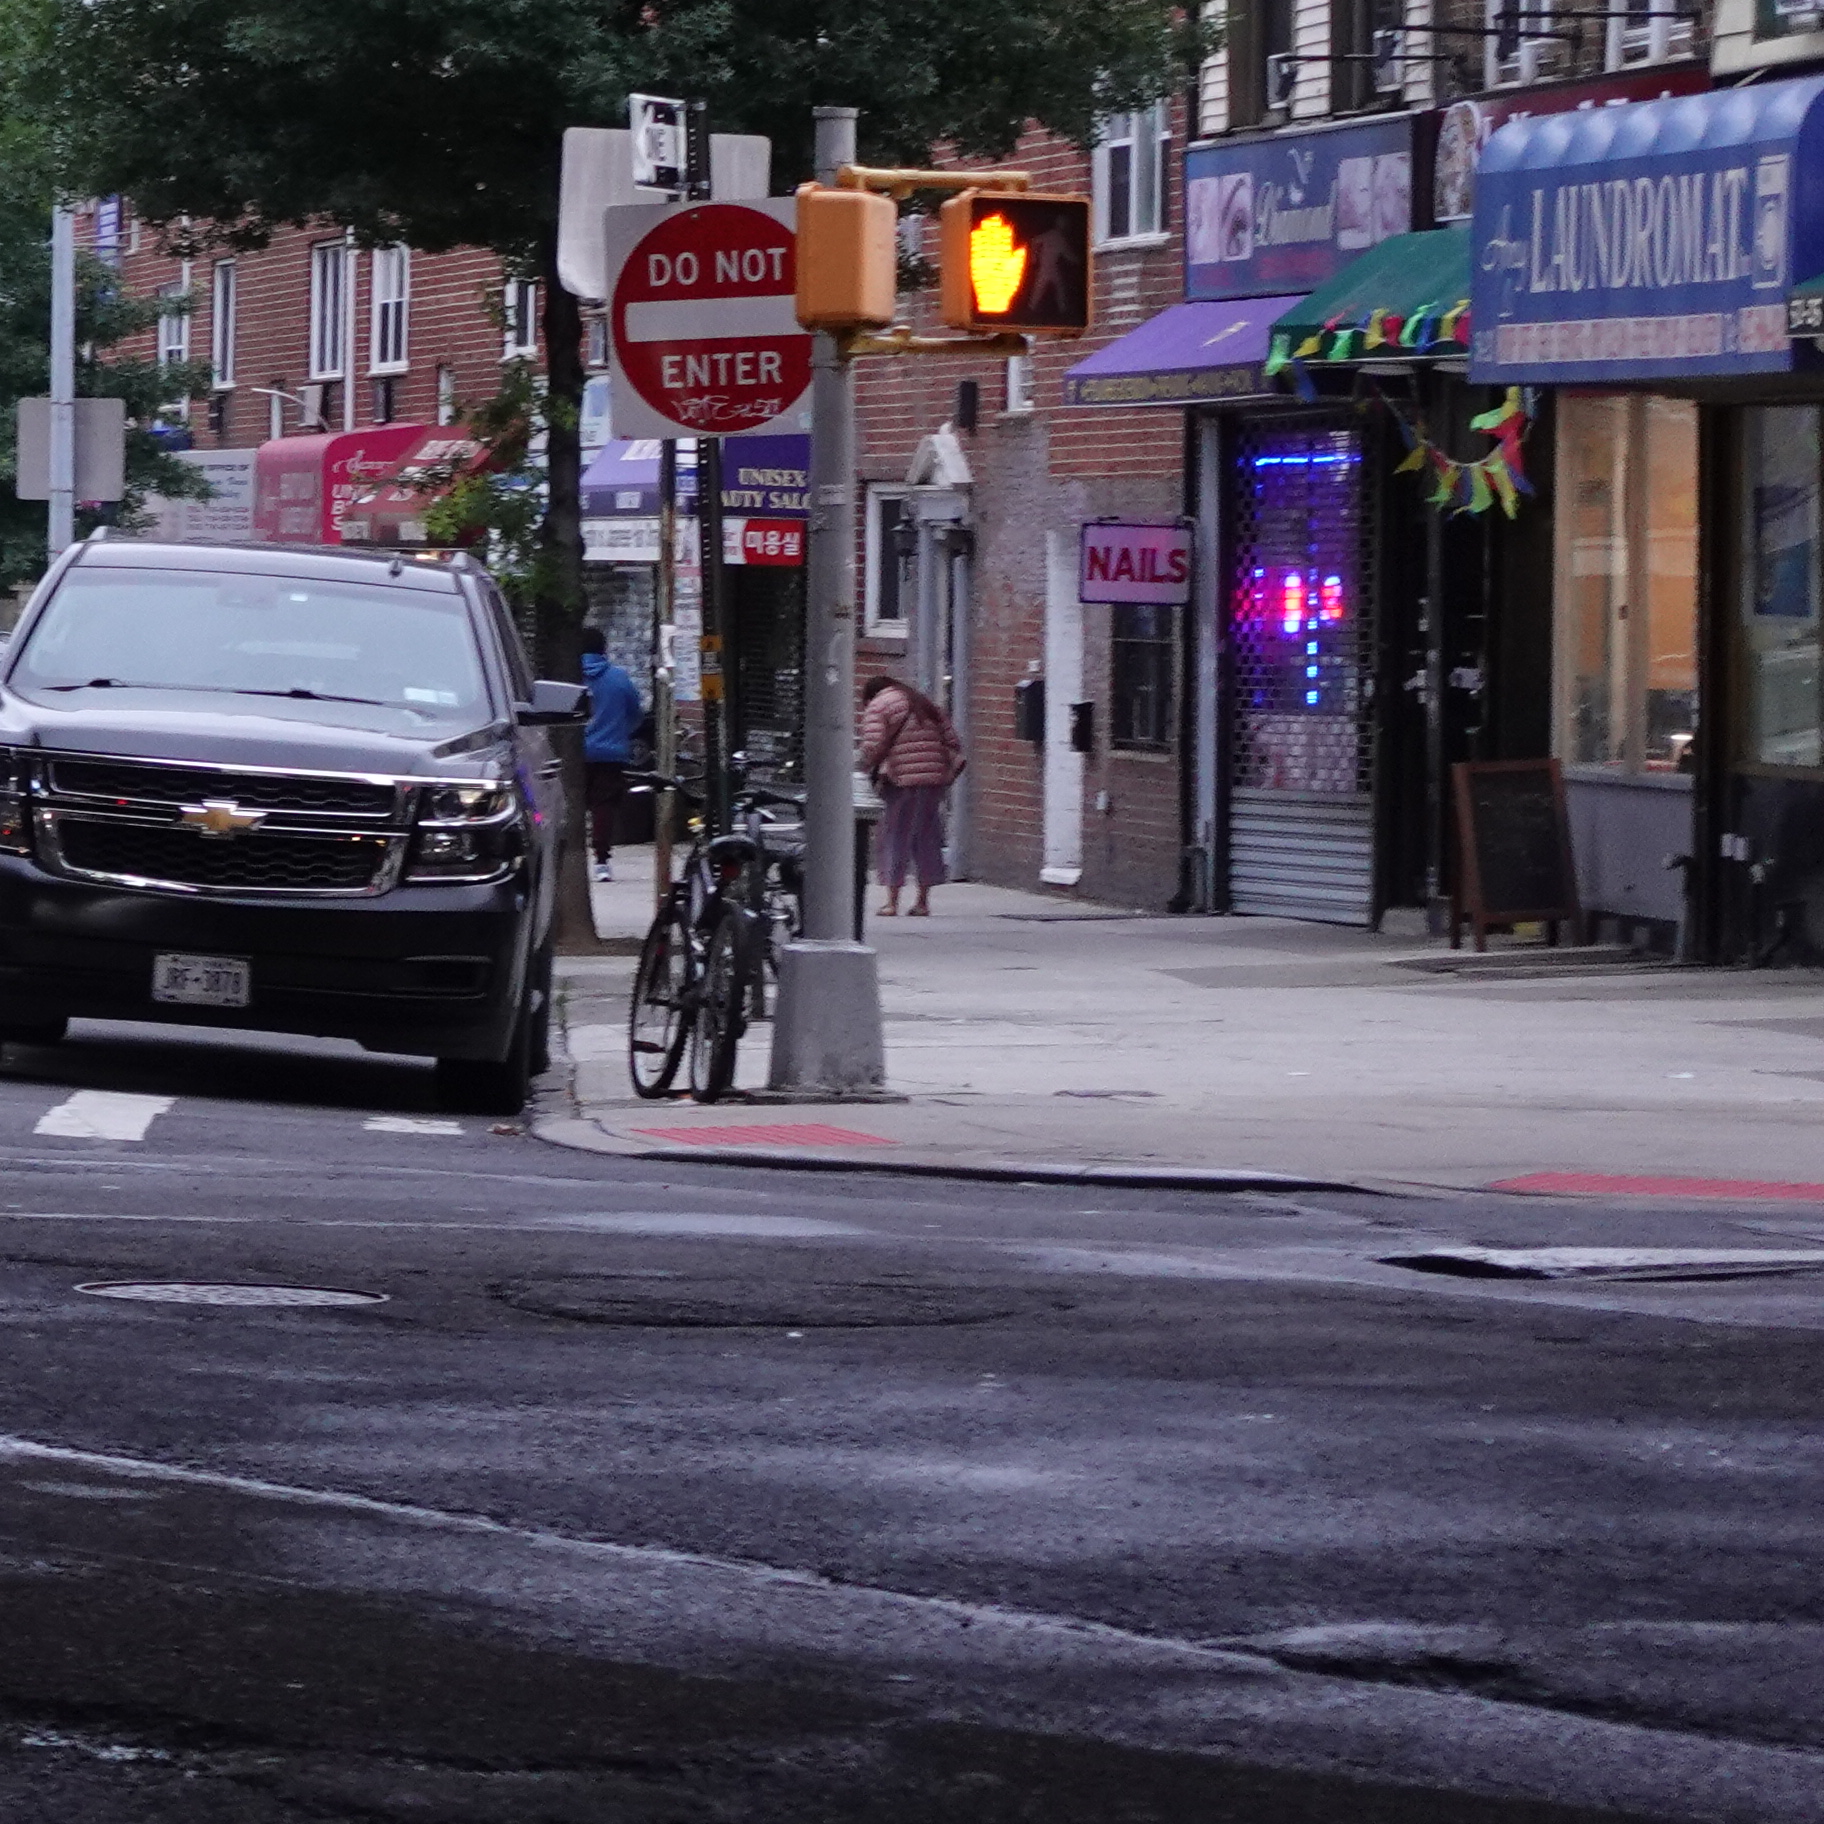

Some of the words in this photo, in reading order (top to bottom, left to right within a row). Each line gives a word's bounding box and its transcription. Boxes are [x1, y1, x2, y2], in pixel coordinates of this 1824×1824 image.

[647, 251, 699, 288] DO
[714, 246, 787, 283] NOT
[661, 350, 783, 389] ENTER
[738, 467, 807, 488] UNISEX
[721, 490, 767, 508] AUTY
[745, 530, 802, 557] 미용실
[1085, 546, 1190, 584] NAILS
